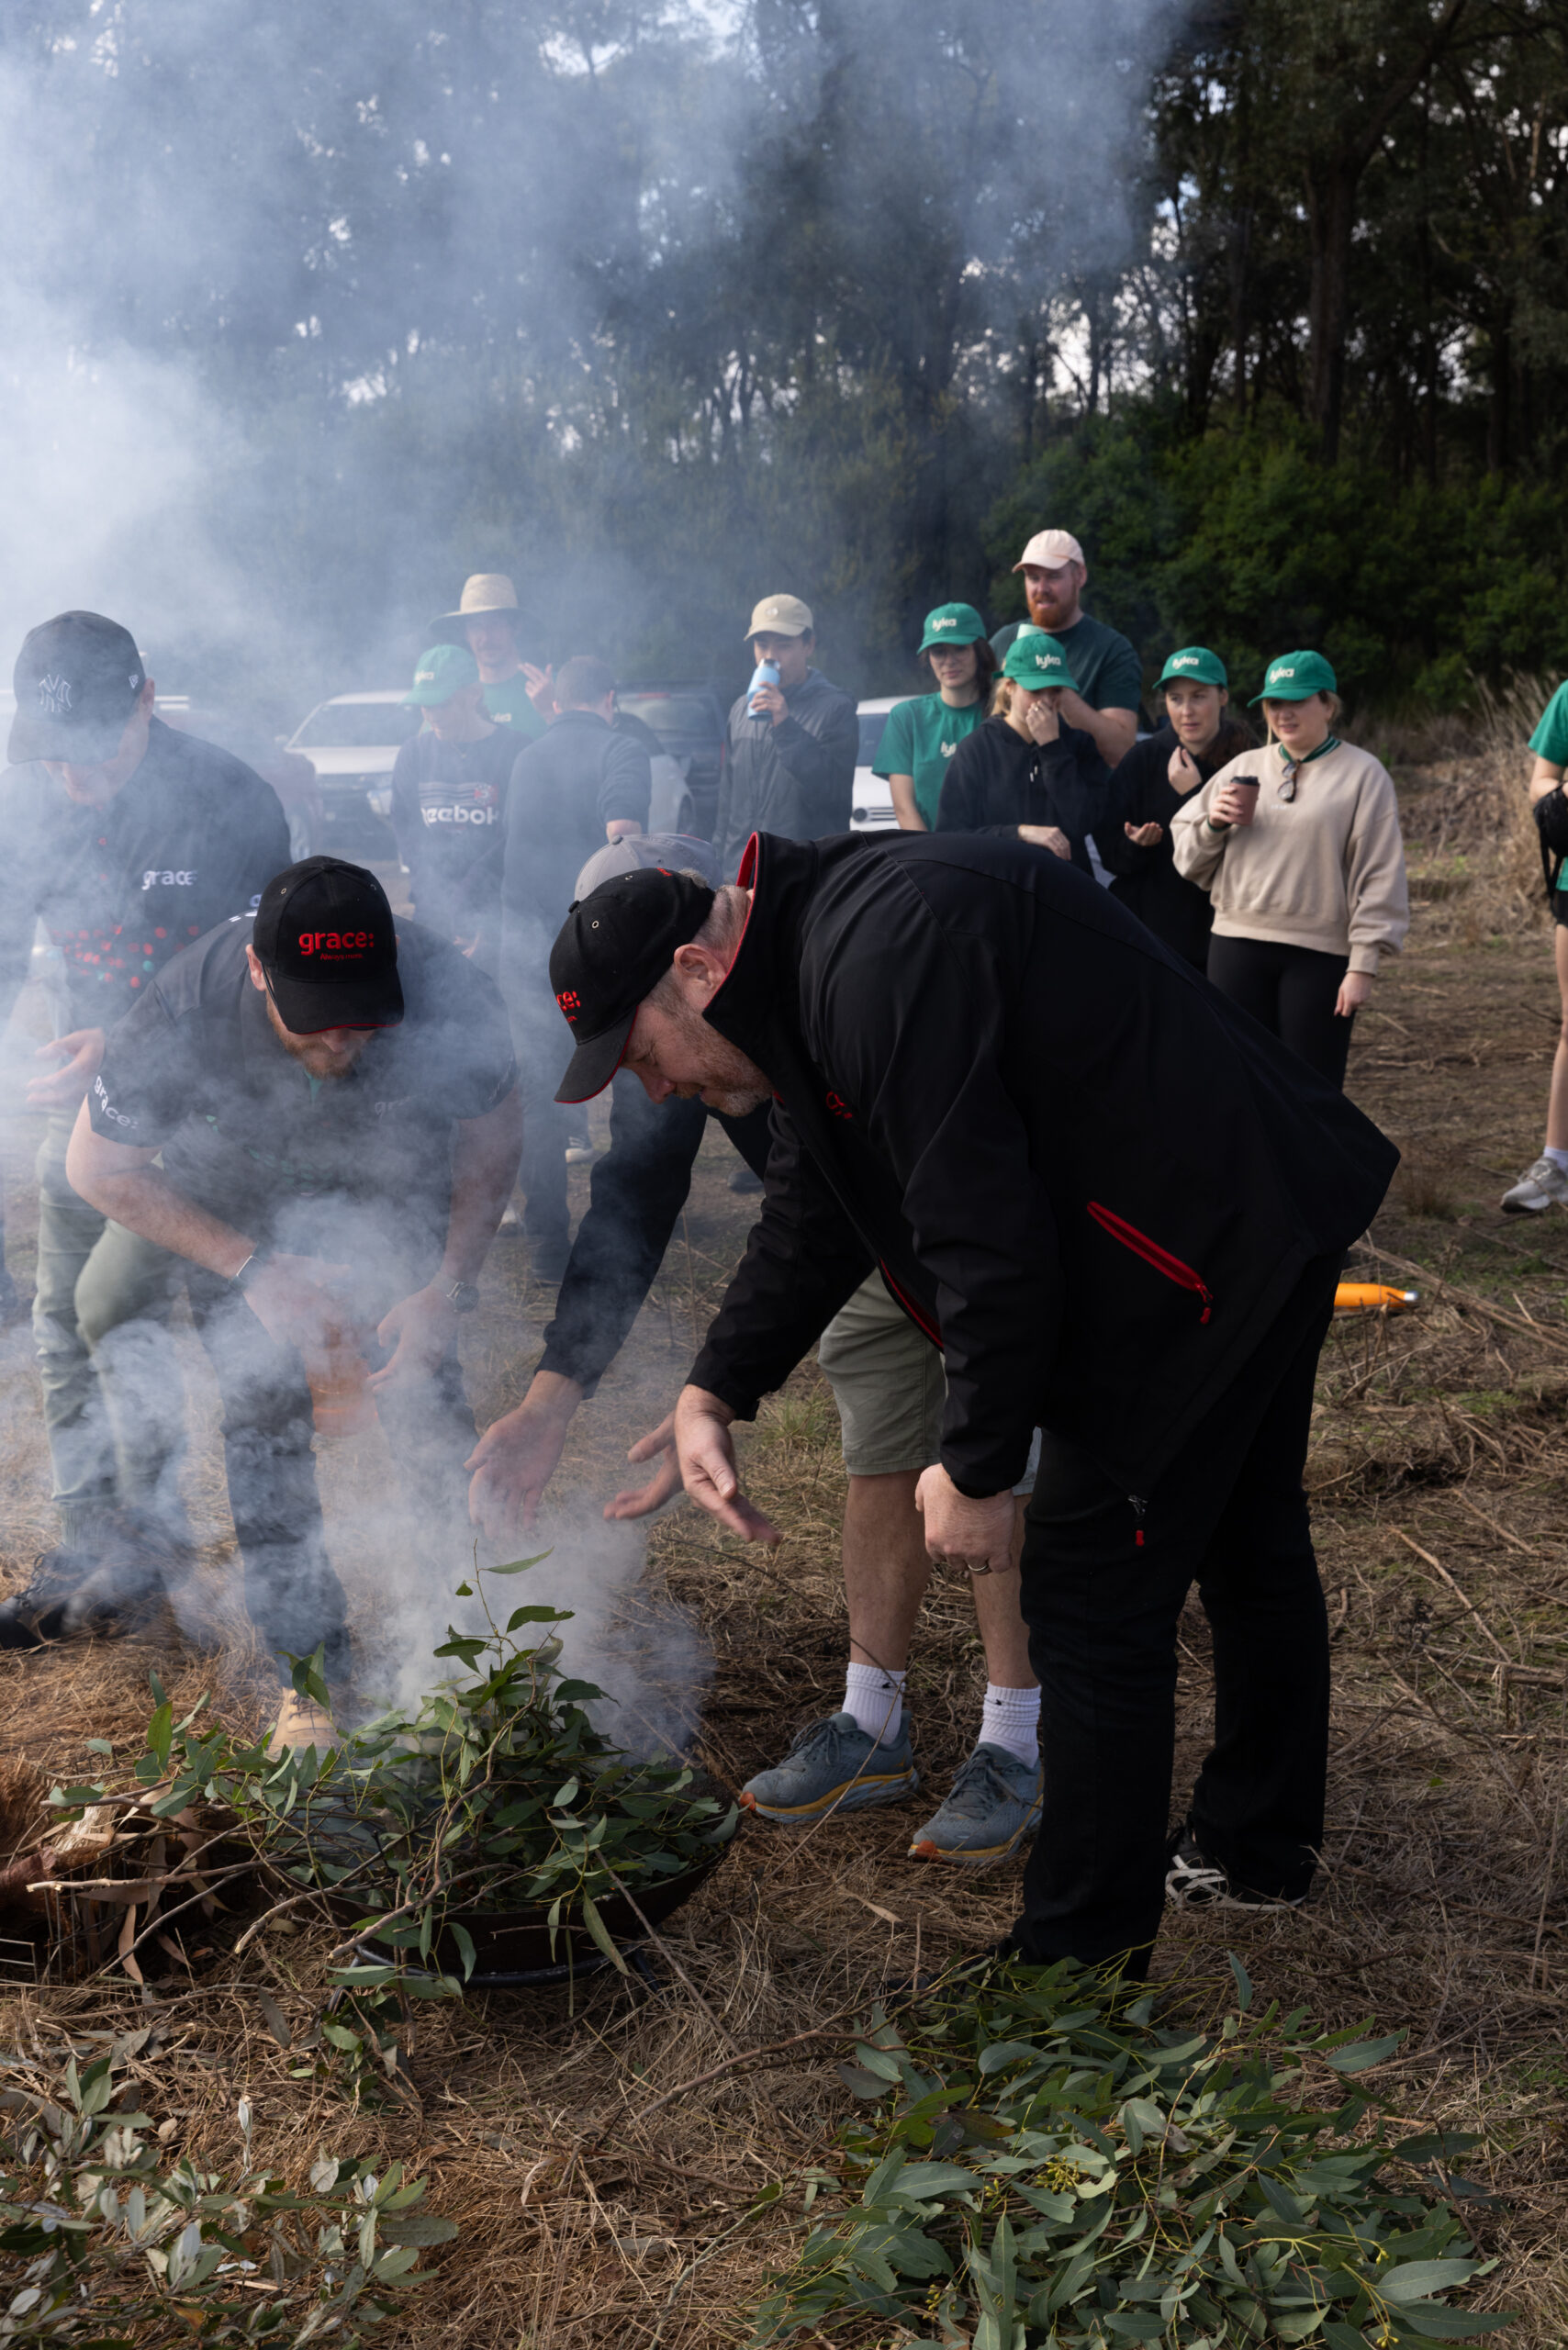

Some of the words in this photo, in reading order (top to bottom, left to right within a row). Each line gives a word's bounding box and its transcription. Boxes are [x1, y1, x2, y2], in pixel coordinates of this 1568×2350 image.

[932, 616, 958, 632] lyka
[1035, 654, 1062, 670] lyka
[1172, 655, 1200, 670] lyka
[1269, 666, 1295, 684] lyka
[940, 741, 958, 758] ly
[298, 931, 375, 957] grace:
[94, 1075, 140, 1130] grace:
